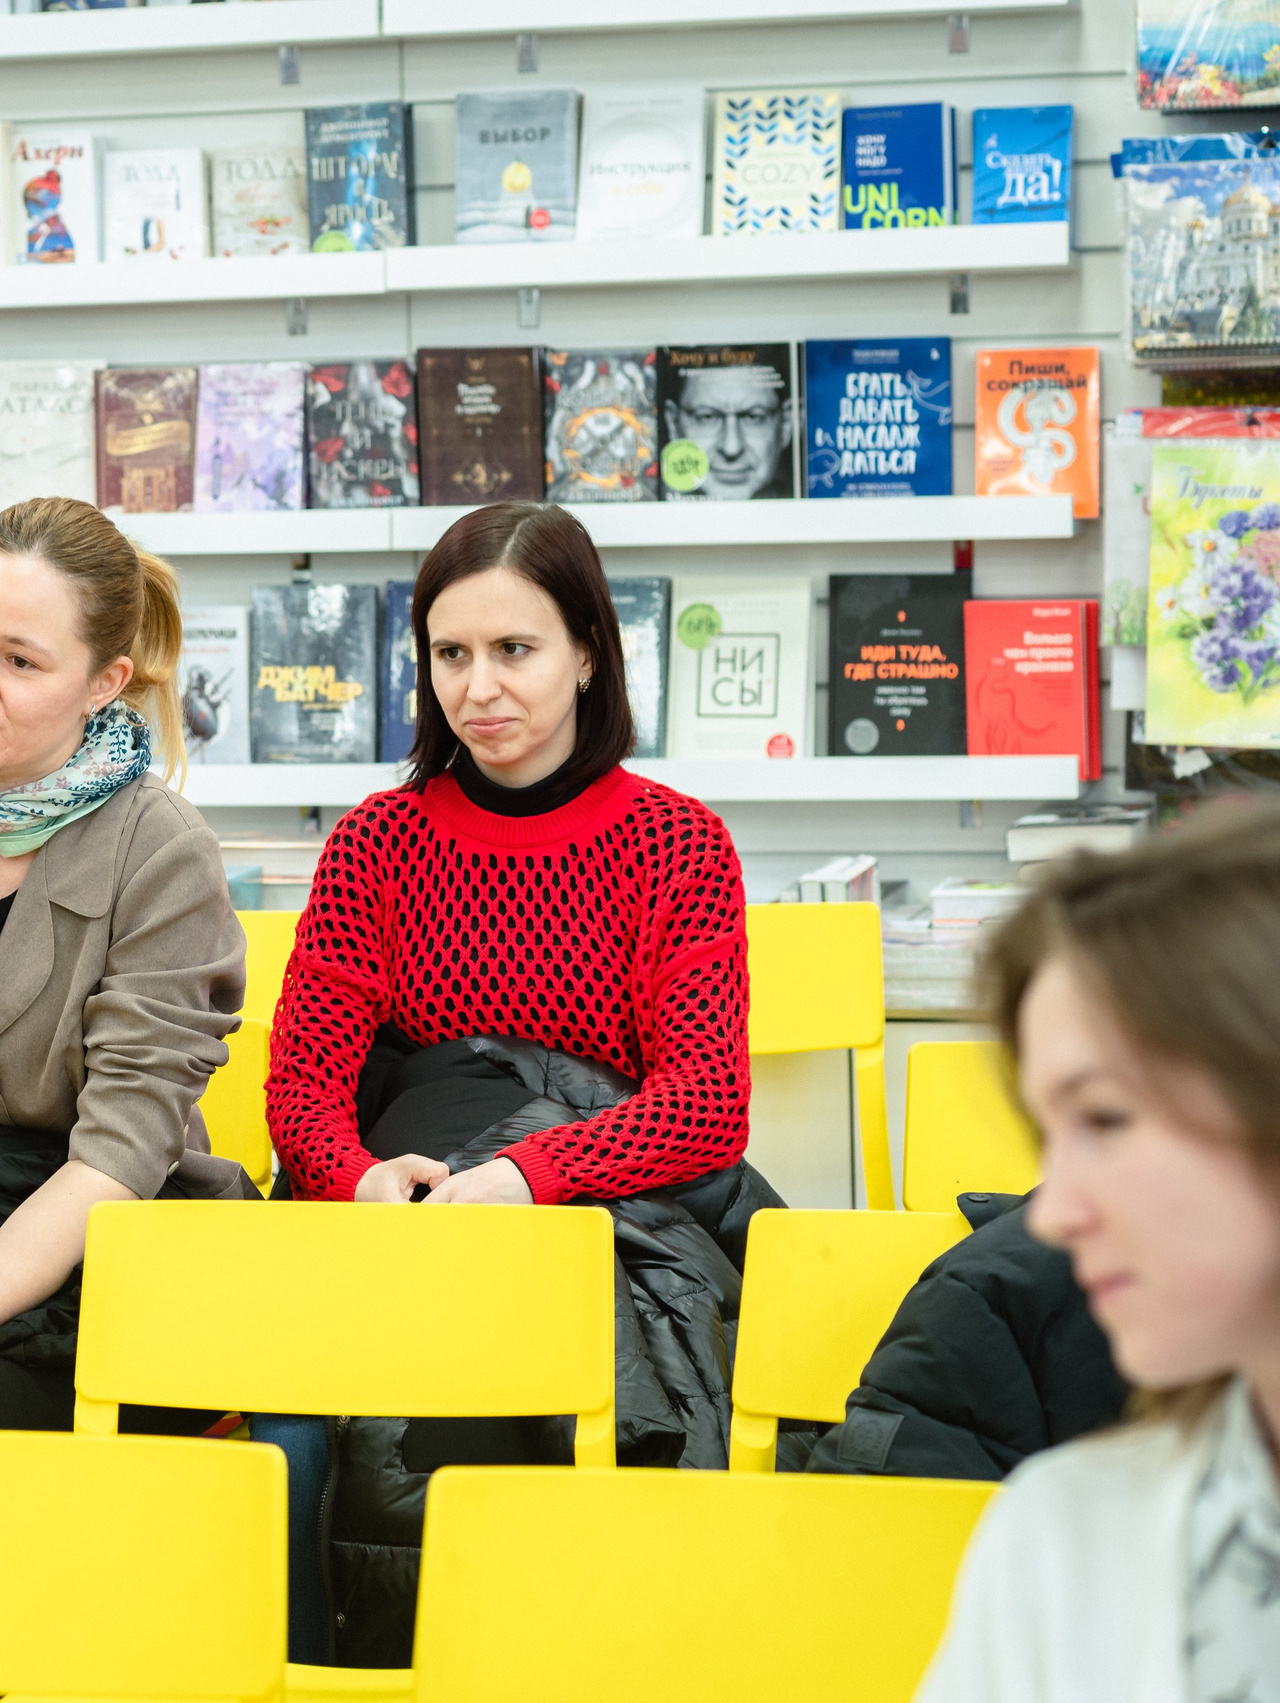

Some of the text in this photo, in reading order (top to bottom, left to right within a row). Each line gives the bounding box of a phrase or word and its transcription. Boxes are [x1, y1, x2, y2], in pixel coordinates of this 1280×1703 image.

[479, 127, 551, 144] ВЫБОР
[13, 140, 84, 165] Ахерн
[986, 151, 1052, 168] Сказать
[312, 151, 399, 181] ШТОРМ
[741, 162, 818, 185] COZY
[997, 158, 1062, 207] да!
[845, 184, 898, 212] UNI
[863, 206, 946, 230] CORN
[1009, 360, 1071, 376] Пиши,
[987, 374, 1087, 394] сокращай
[840, 397, 918, 423] ДАВАТЬ
[840, 450, 916, 476] ДАТЬСЯ
[713, 647, 764, 673] НИ
[860, 645, 947, 662] ИДИ ТУДА,
[844, 663, 959, 681] ГДЕ СТРАШНО
[711, 677, 763, 706] СЫ
